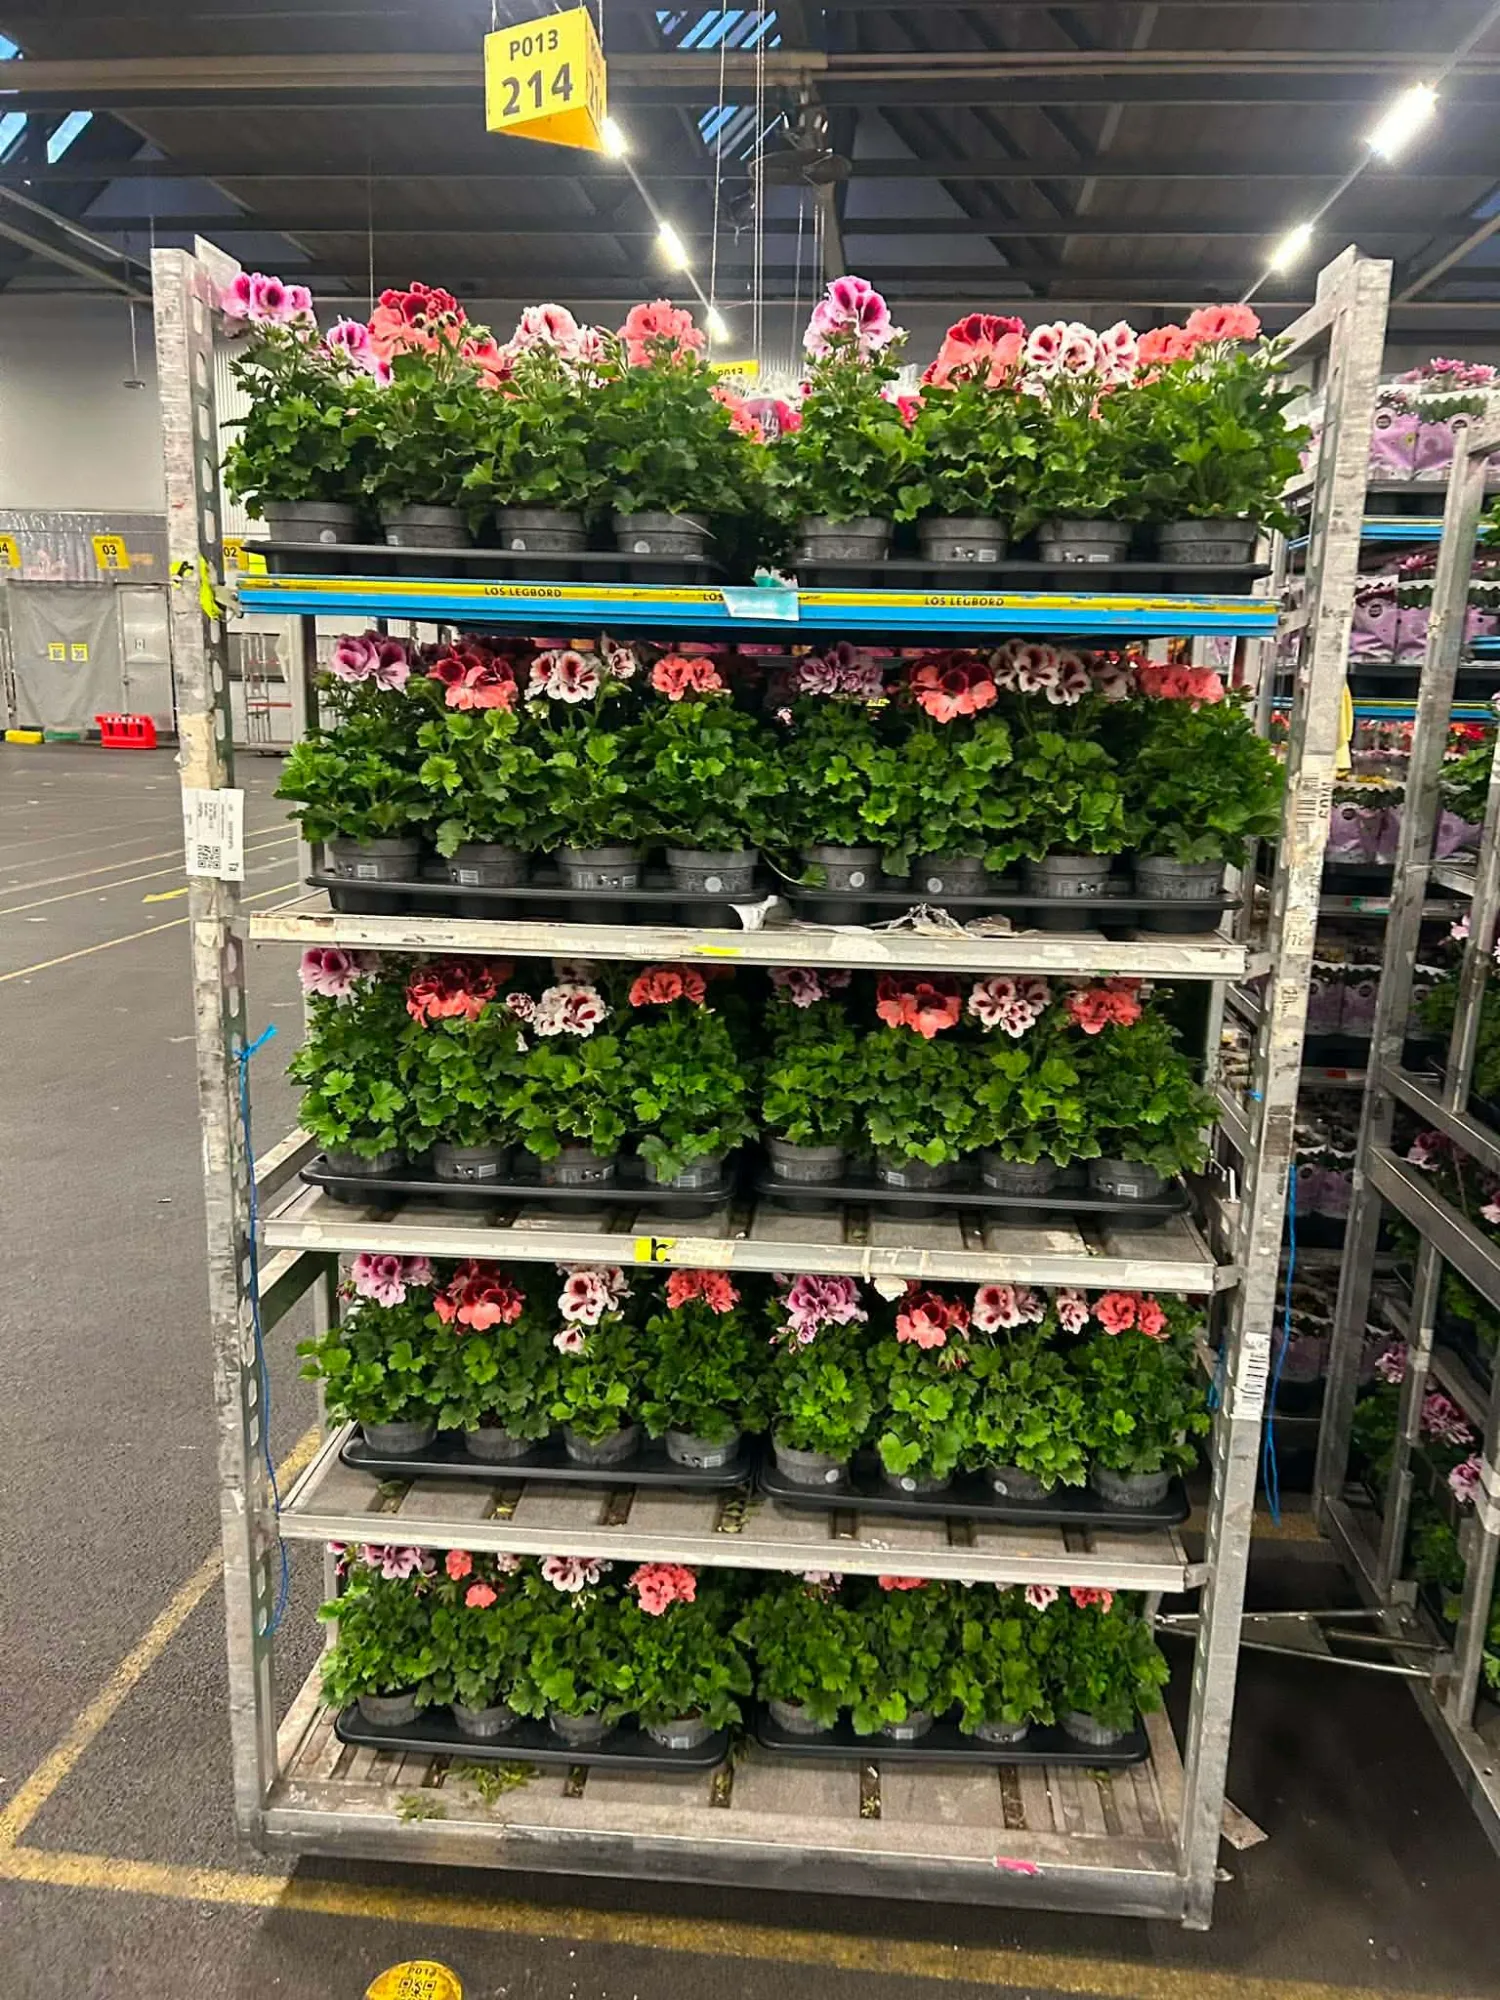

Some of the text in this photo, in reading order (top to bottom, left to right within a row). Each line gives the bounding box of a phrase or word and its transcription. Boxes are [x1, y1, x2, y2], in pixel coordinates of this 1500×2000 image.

[509, 29, 559, 61] P013
[501, 62, 573, 117] 214
[102, 544, 117, 555] 03
[223, 546, 238, 557] 02
[484, 587, 562, 598] LOS LEGBORD
[703, 593, 724, 602] LOS
[924, 597, 1005, 606] LOS LEGBORD
